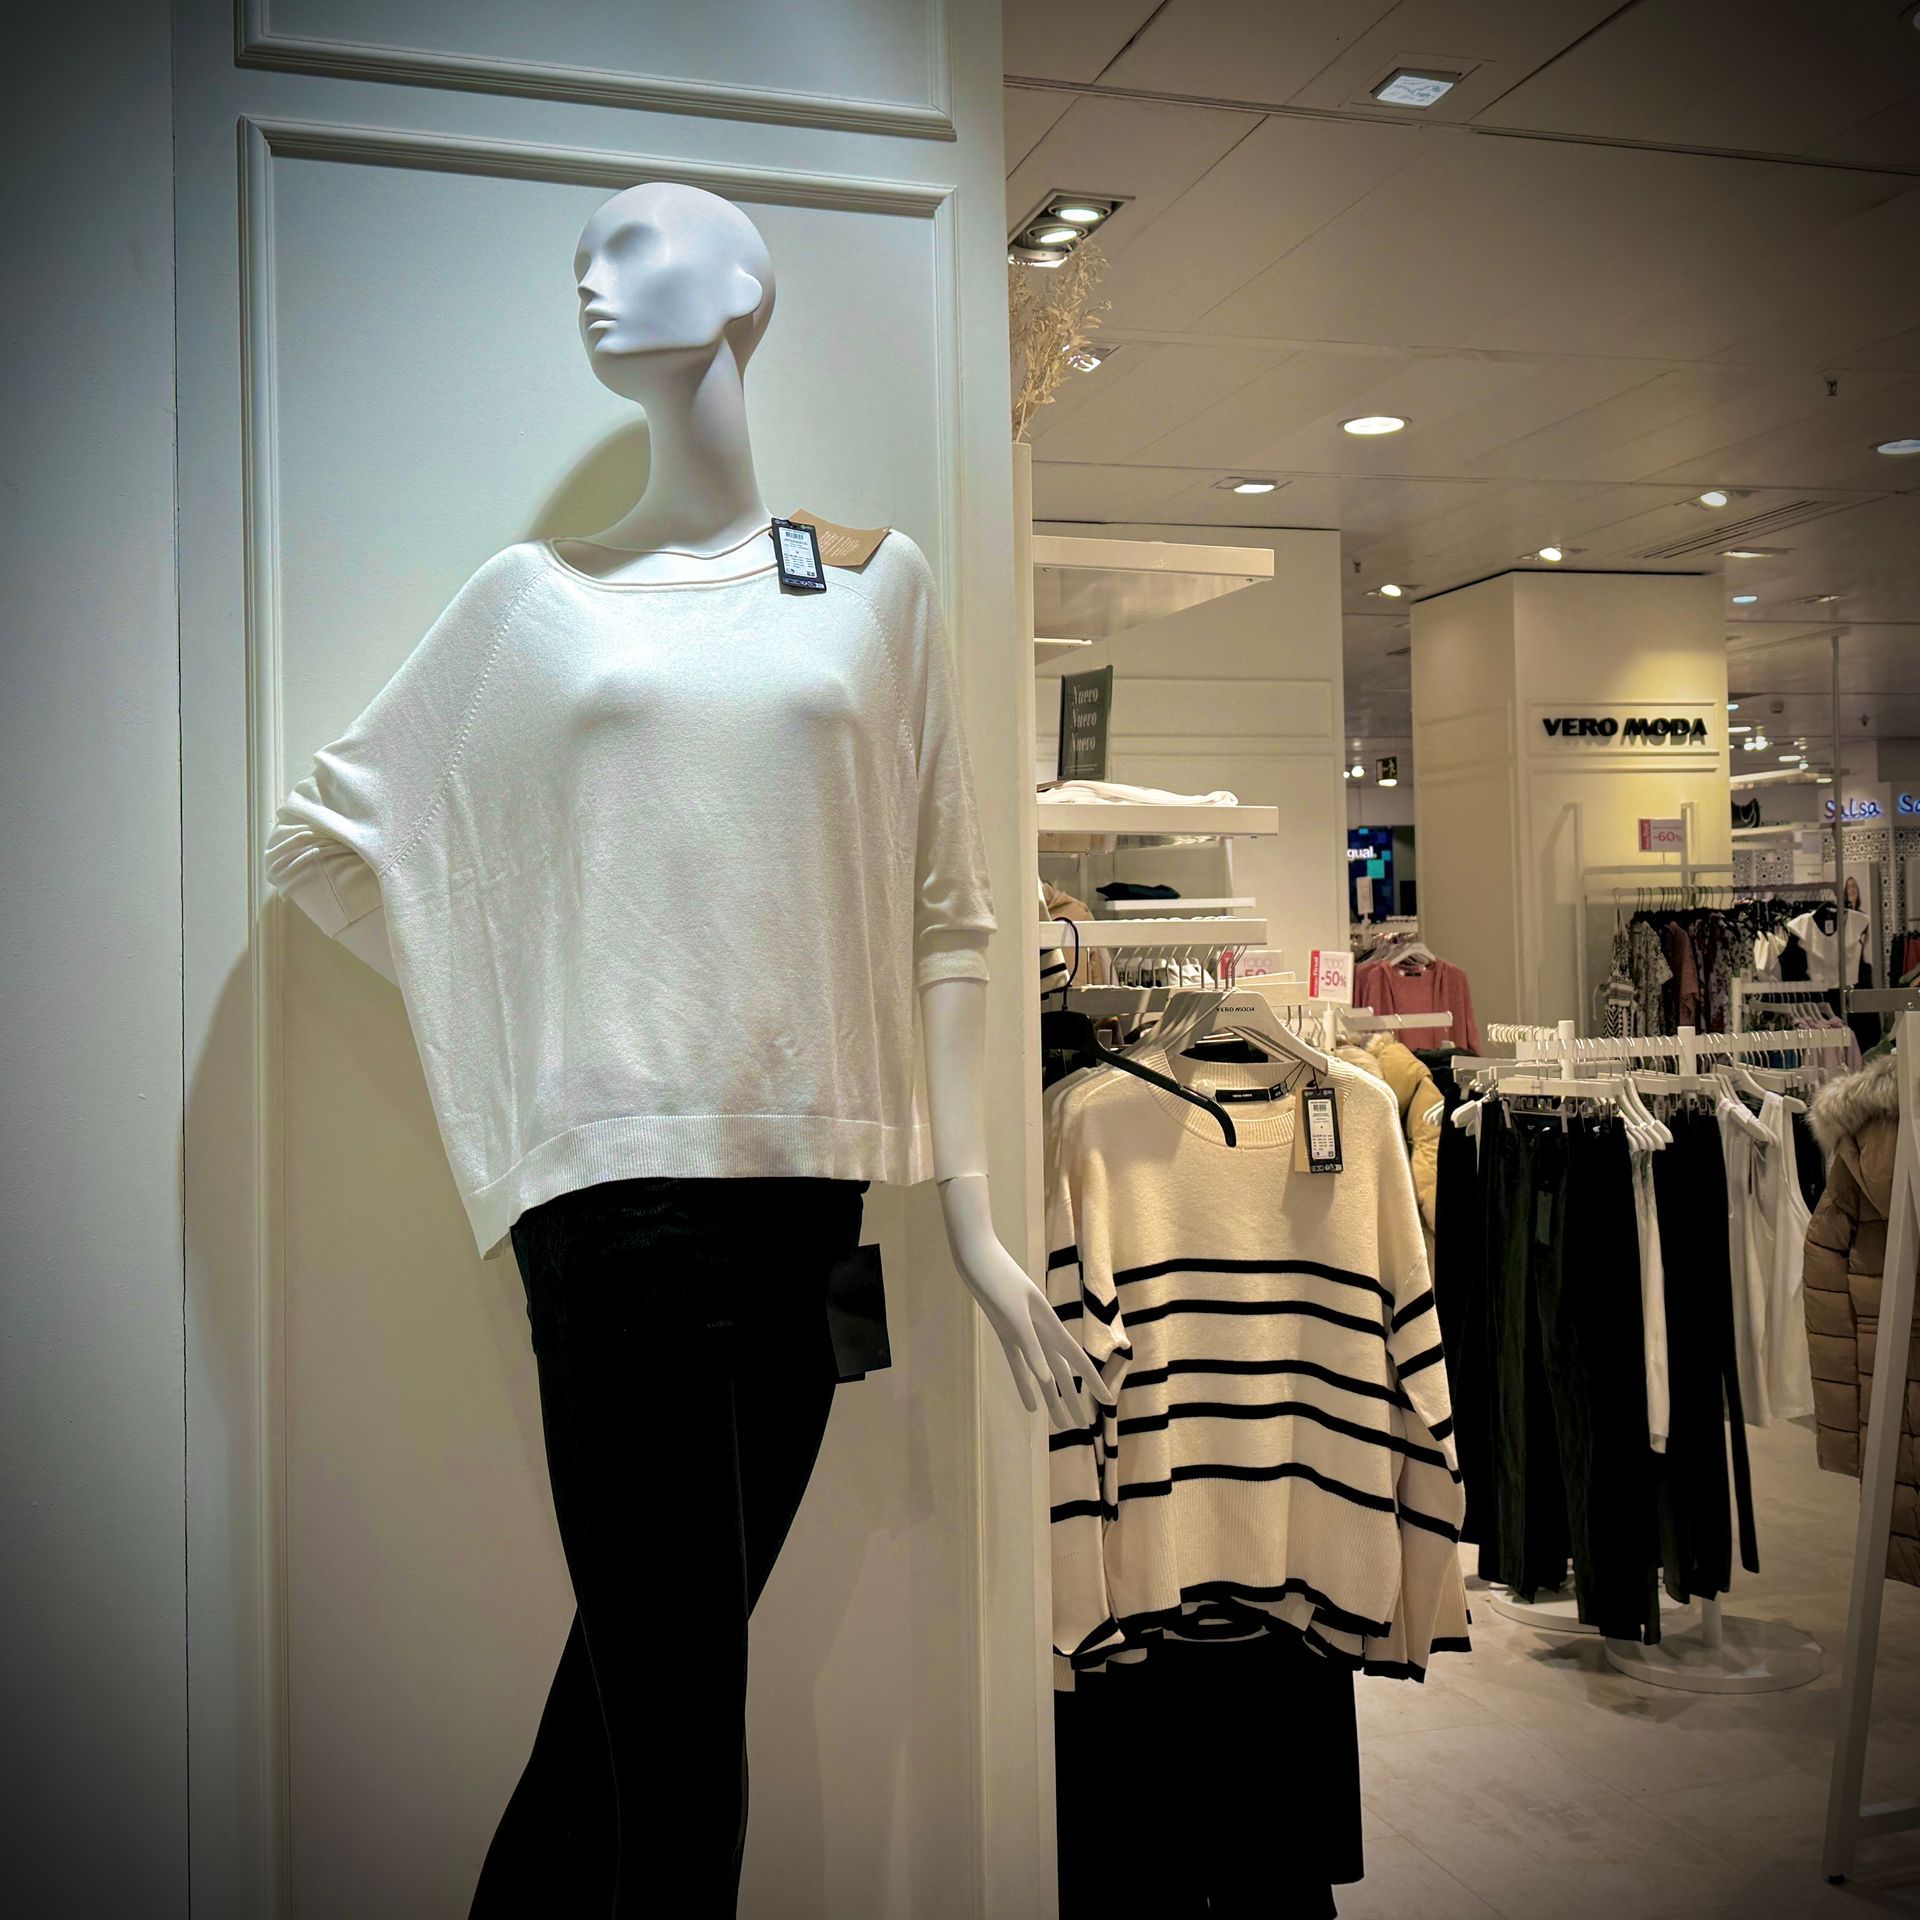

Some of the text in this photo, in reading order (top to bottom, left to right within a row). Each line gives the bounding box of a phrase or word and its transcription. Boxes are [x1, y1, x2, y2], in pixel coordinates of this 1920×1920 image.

[1071, 685, 1099, 705] Nuevo
[1070, 708, 1097, 728] Nuevo
[1542, 717, 1709, 737] VERO MODA
[1070, 731, 1096, 752] Nuevo
[1320, 970, 1347, 987] -50%
